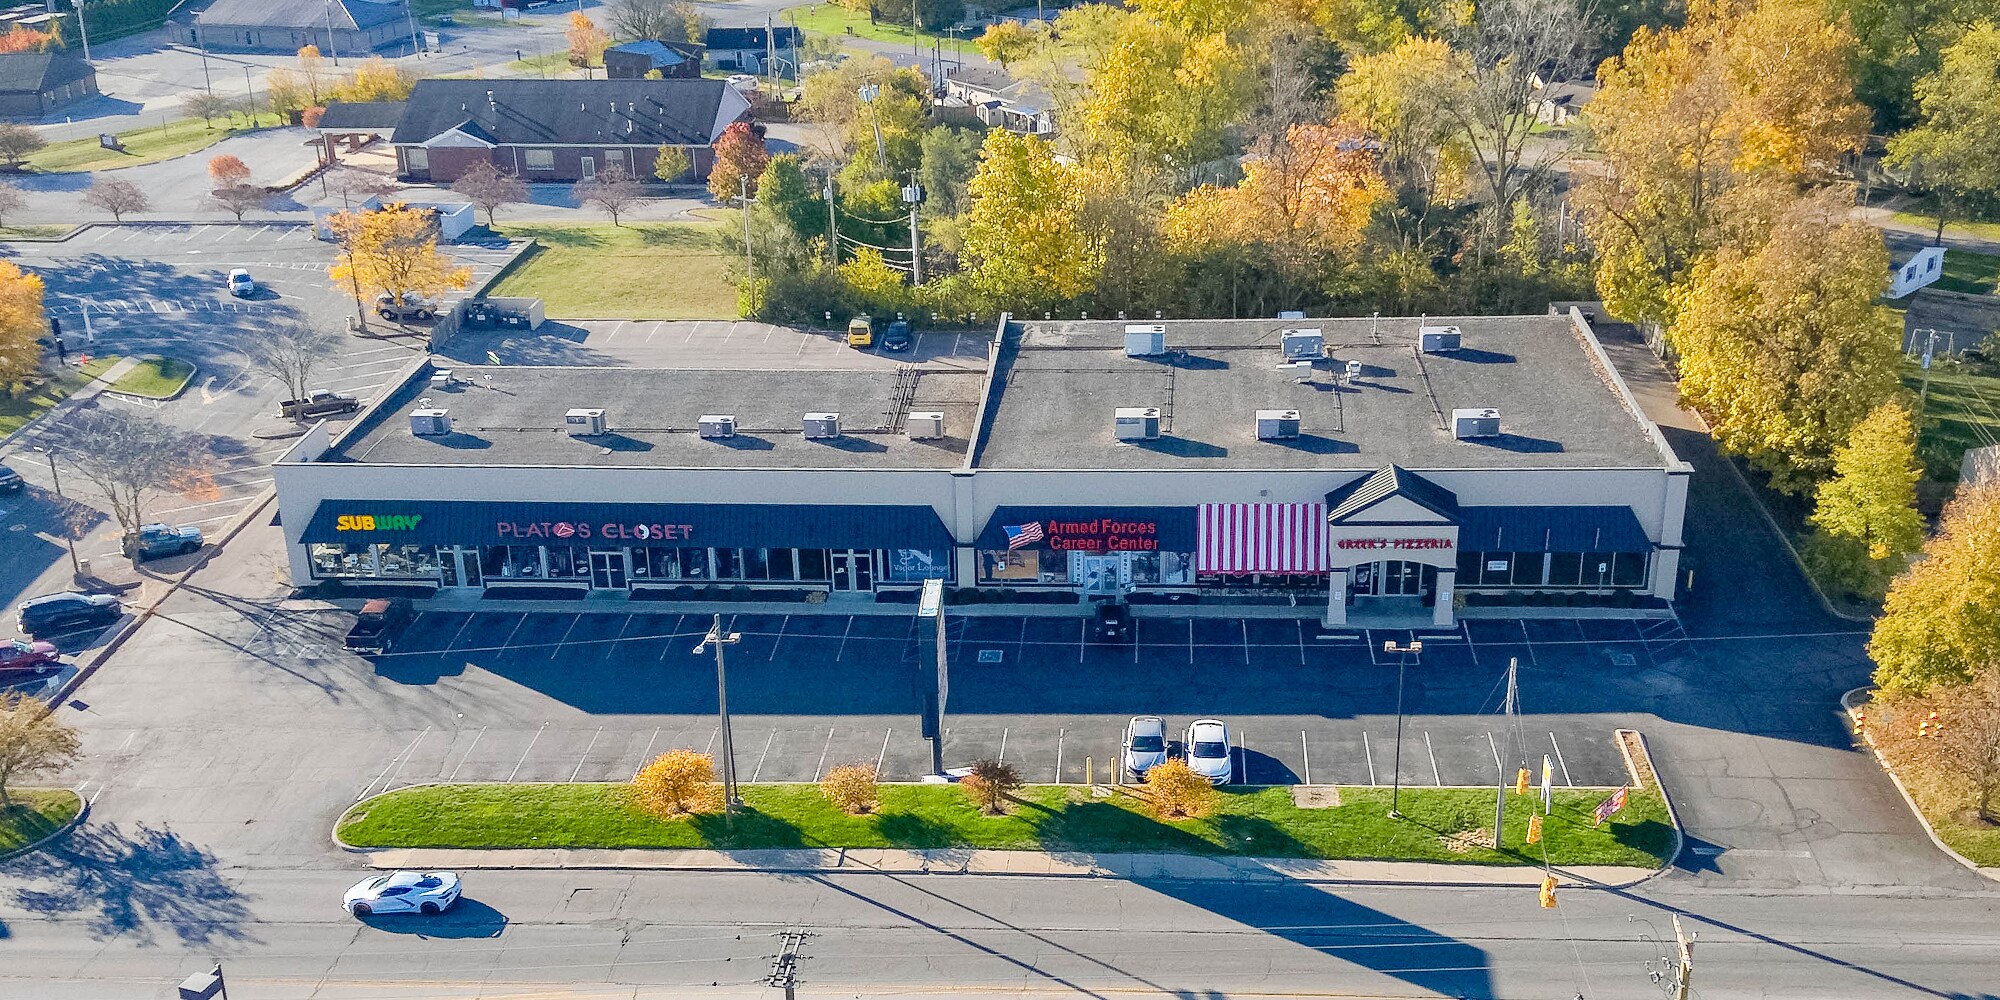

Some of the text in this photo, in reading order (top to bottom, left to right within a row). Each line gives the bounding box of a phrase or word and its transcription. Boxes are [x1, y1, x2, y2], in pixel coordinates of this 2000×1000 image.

[336, 515, 422, 530] SUBWAY
[1048, 519, 1156, 534] Armed Forces
[497, 522, 693, 540] PLATO'S CLOSET
[1050, 535, 1159, 550] Career Center
[1392, 538, 1453, 550] PIZZERIA
[893, 562, 948, 573] Vapor Lounge
